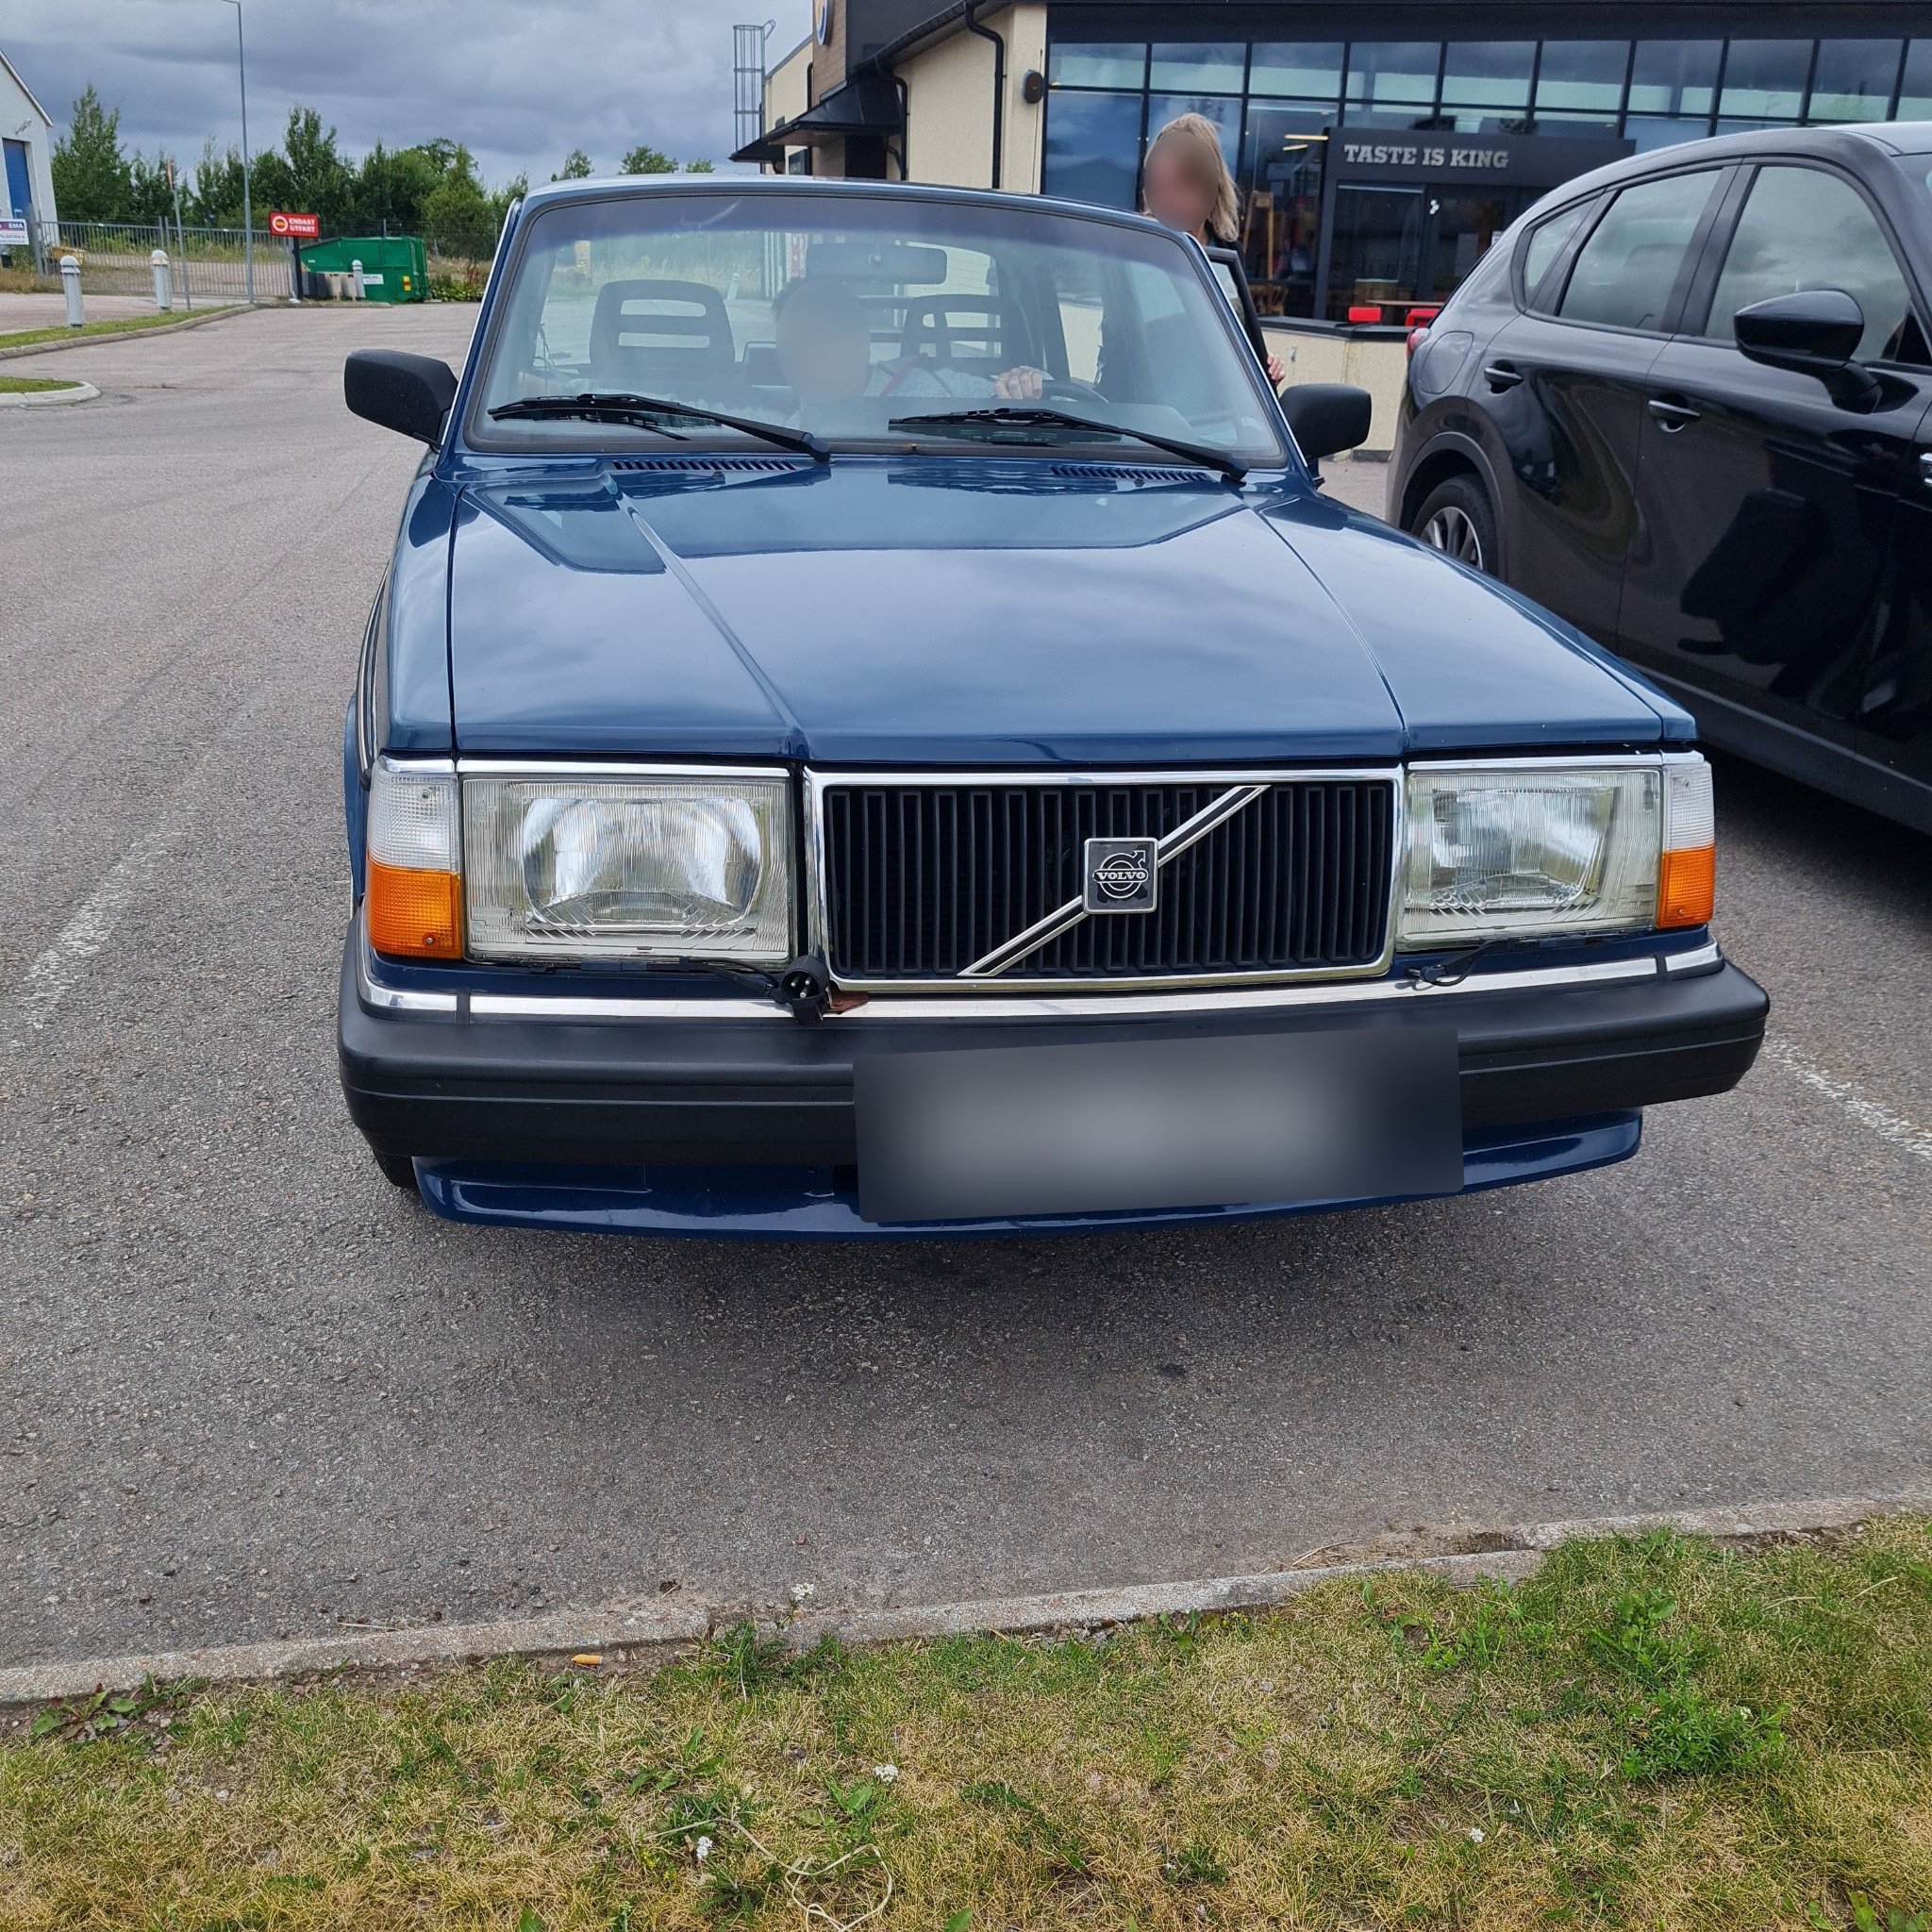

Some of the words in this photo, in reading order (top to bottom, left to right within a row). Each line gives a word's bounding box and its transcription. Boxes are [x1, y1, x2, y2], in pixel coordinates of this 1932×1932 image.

[1343, 144, 1417, 165] TASTE
[1422, 148, 1445, 167] IS
[1449, 149, 1509, 169] KING
